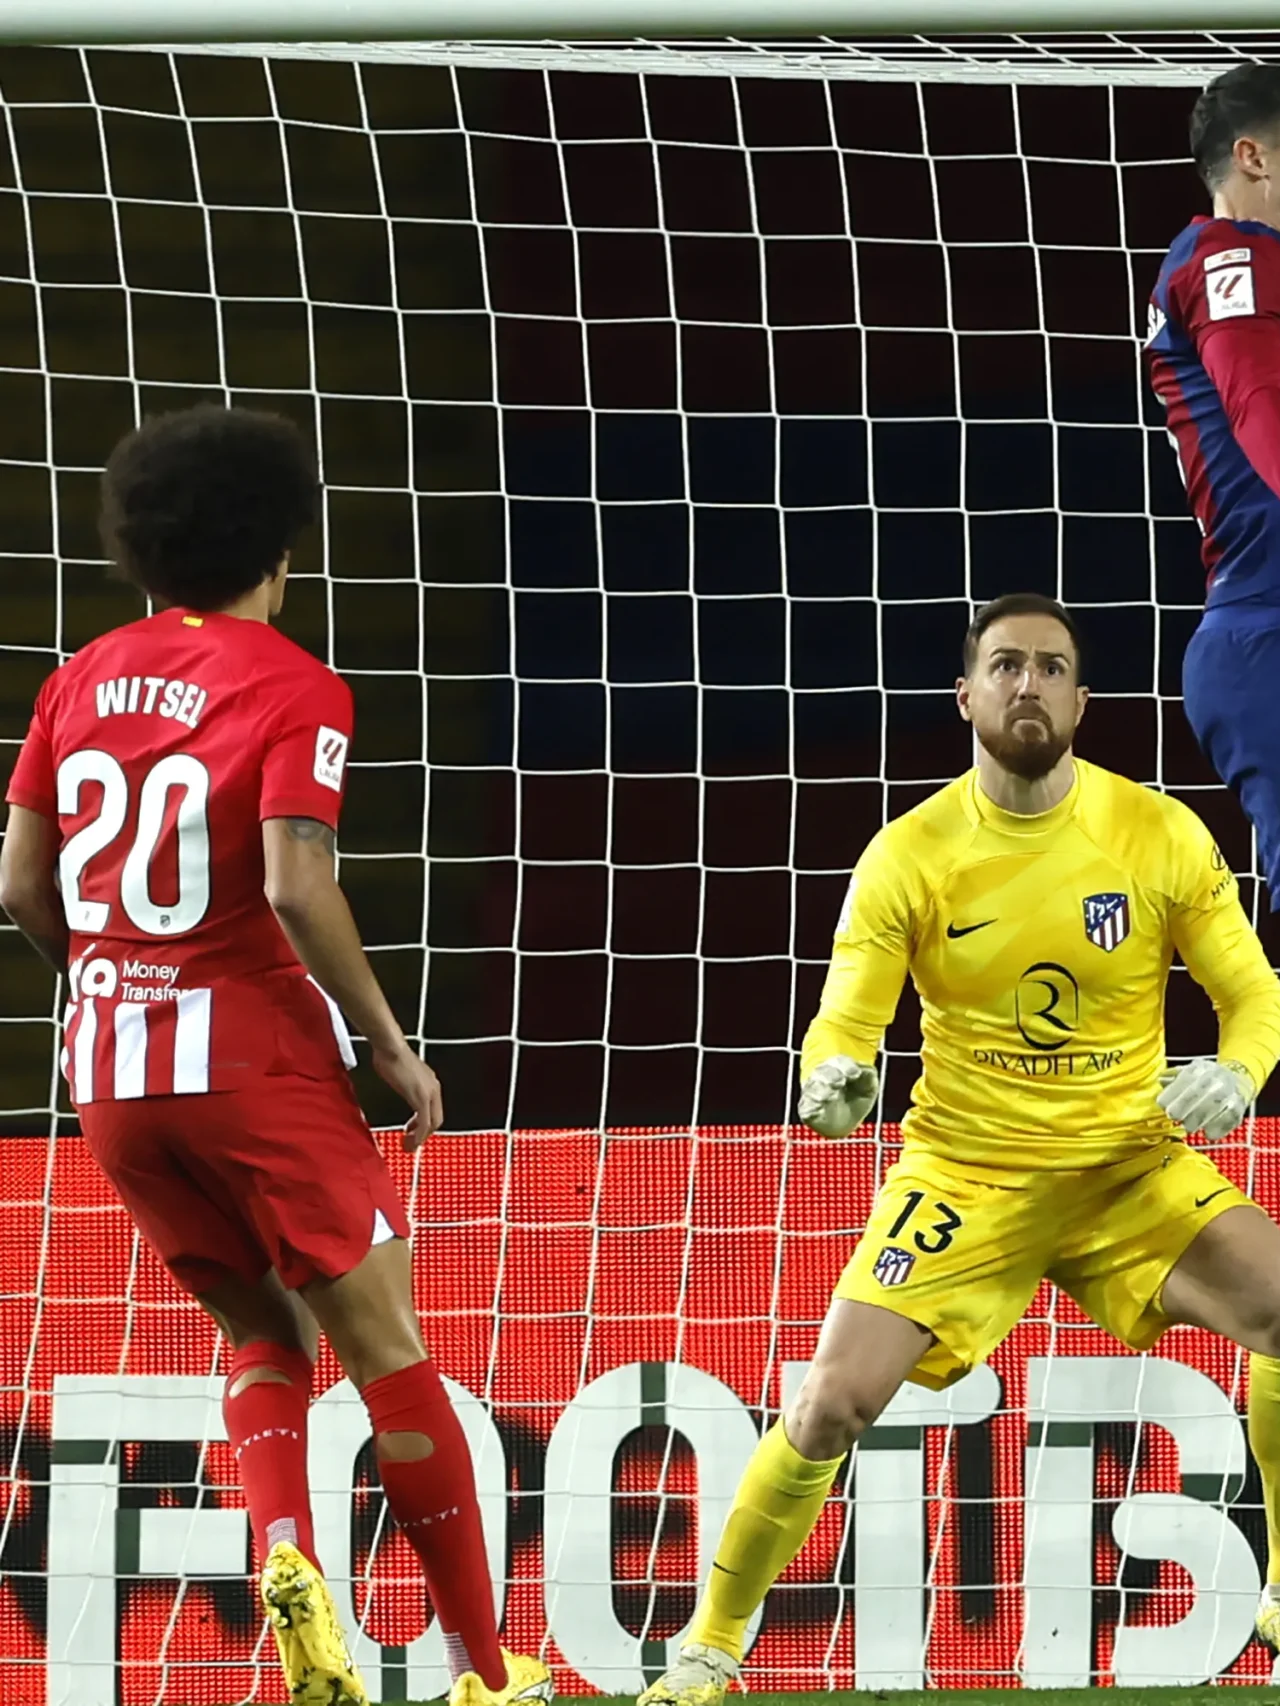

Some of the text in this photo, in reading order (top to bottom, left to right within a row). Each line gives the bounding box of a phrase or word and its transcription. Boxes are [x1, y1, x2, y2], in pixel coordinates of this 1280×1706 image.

[96, 676, 208, 730] WITSEL
[56, 749, 211, 936] 20
[122, 960, 180, 984] Money
[1082, 1049, 1124, 1075] AIR
[887, 1191, 963, 1254] 13
